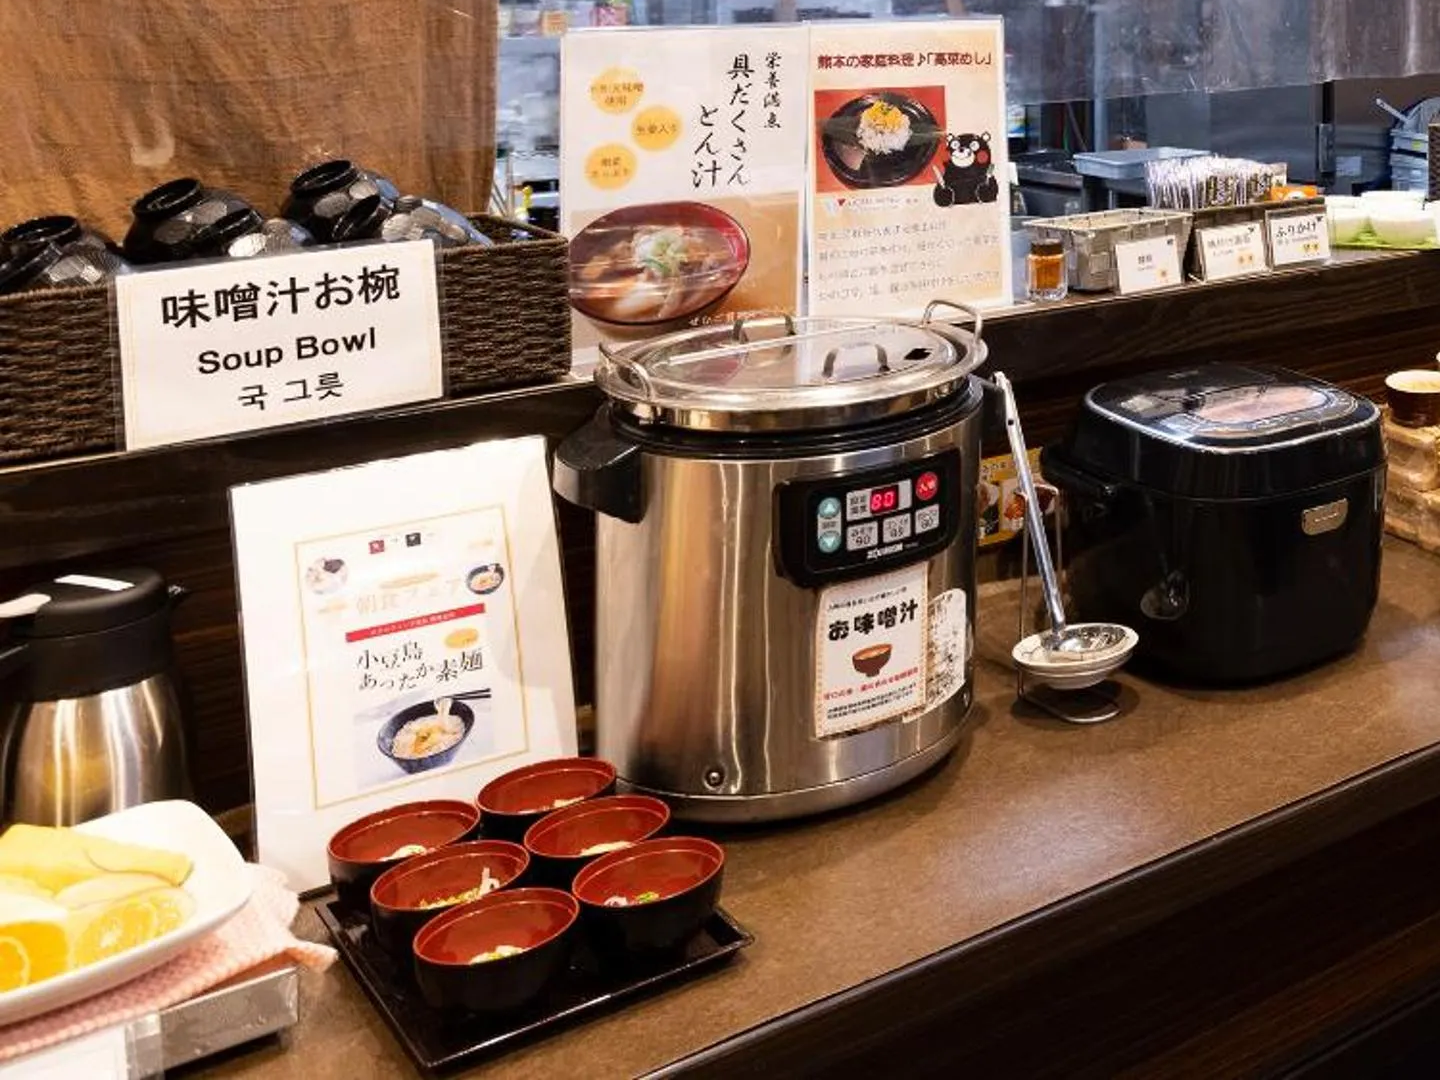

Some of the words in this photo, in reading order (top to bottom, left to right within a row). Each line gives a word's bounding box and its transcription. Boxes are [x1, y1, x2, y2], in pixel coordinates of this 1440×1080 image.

[727, 53, 754, 188] 具だくさん
[692, 105, 720, 188] とん汁
[1276, 220, 1318, 239] ふりかけ
[161, 264, 401, 330] 味噌汁お椀
[197, 342, 284, 376] Soup
[296, 327, 377, 361] Bowl
[238, 383, 269, 412] 국
[283, 372, 347, 405] 그릇
[871, 490, 896, 512] 80
[828, 598, 919, 641] お味噌汁
